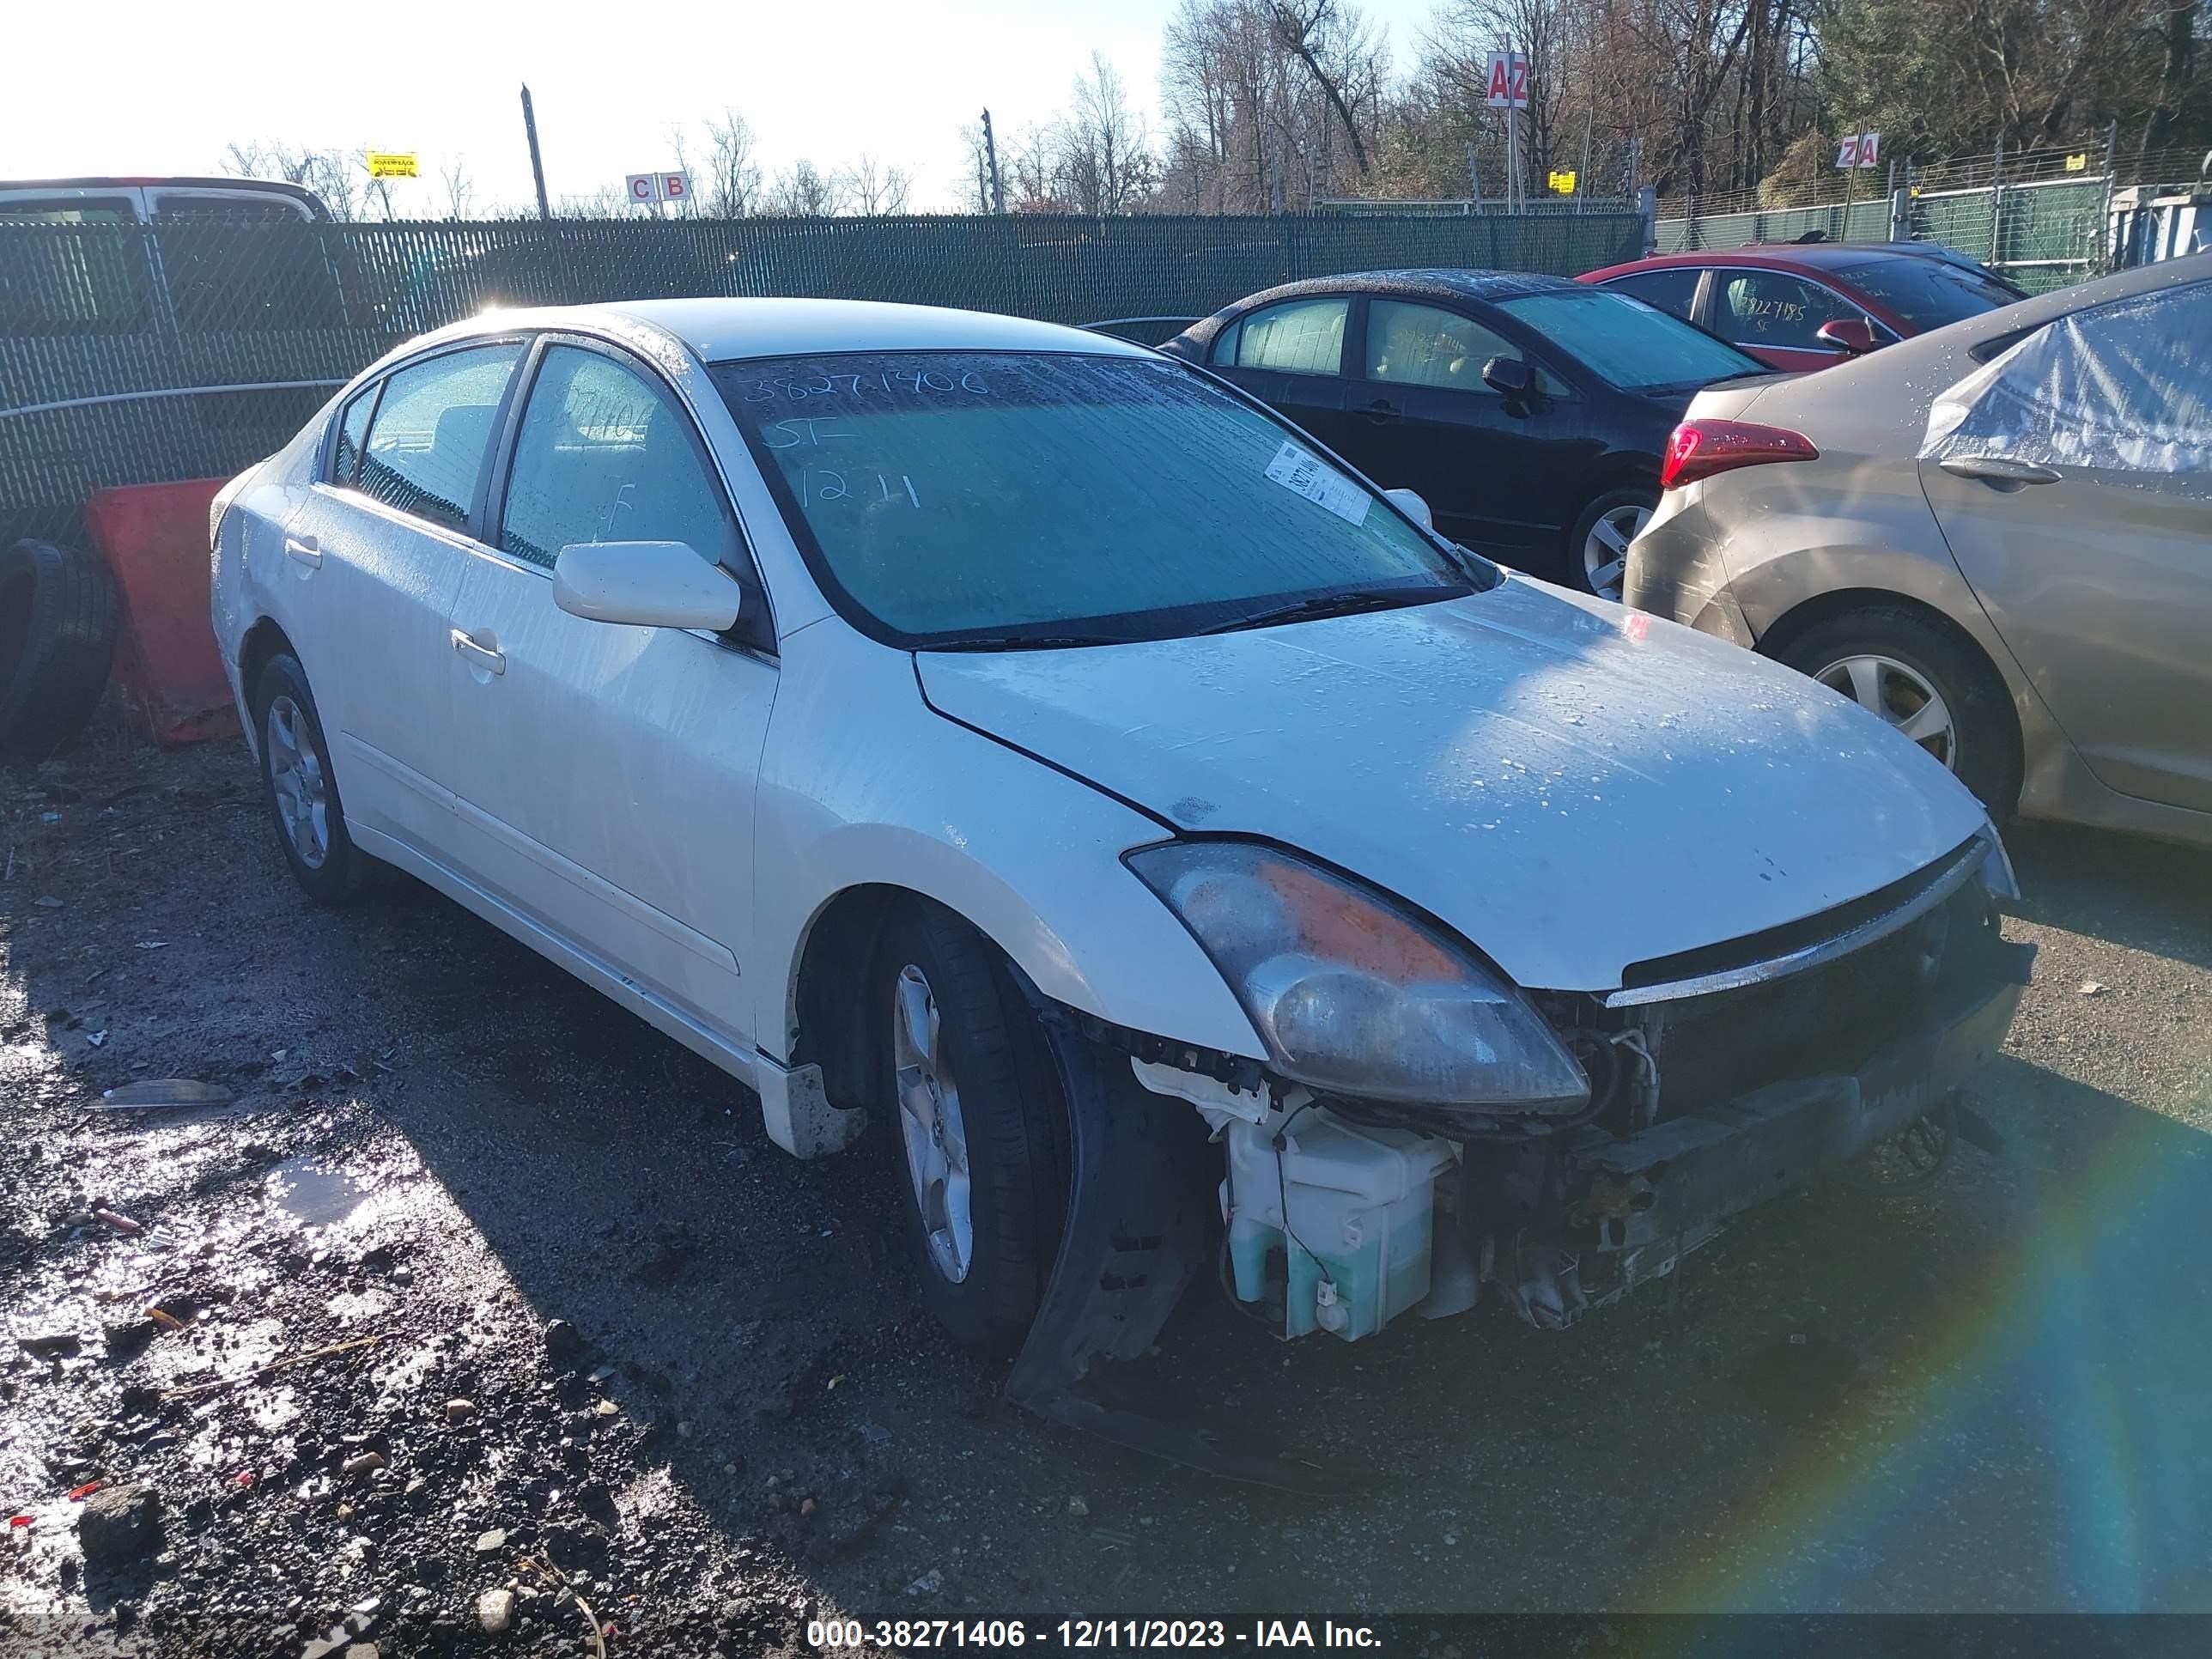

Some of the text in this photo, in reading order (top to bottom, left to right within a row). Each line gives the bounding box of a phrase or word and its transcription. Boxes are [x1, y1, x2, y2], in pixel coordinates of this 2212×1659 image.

[633, 179, 650, 198] C
[666, 177, 684, 197] B
[740, 371, 989, 402] 38271406
[802, 470, 921, 508] 12 11
